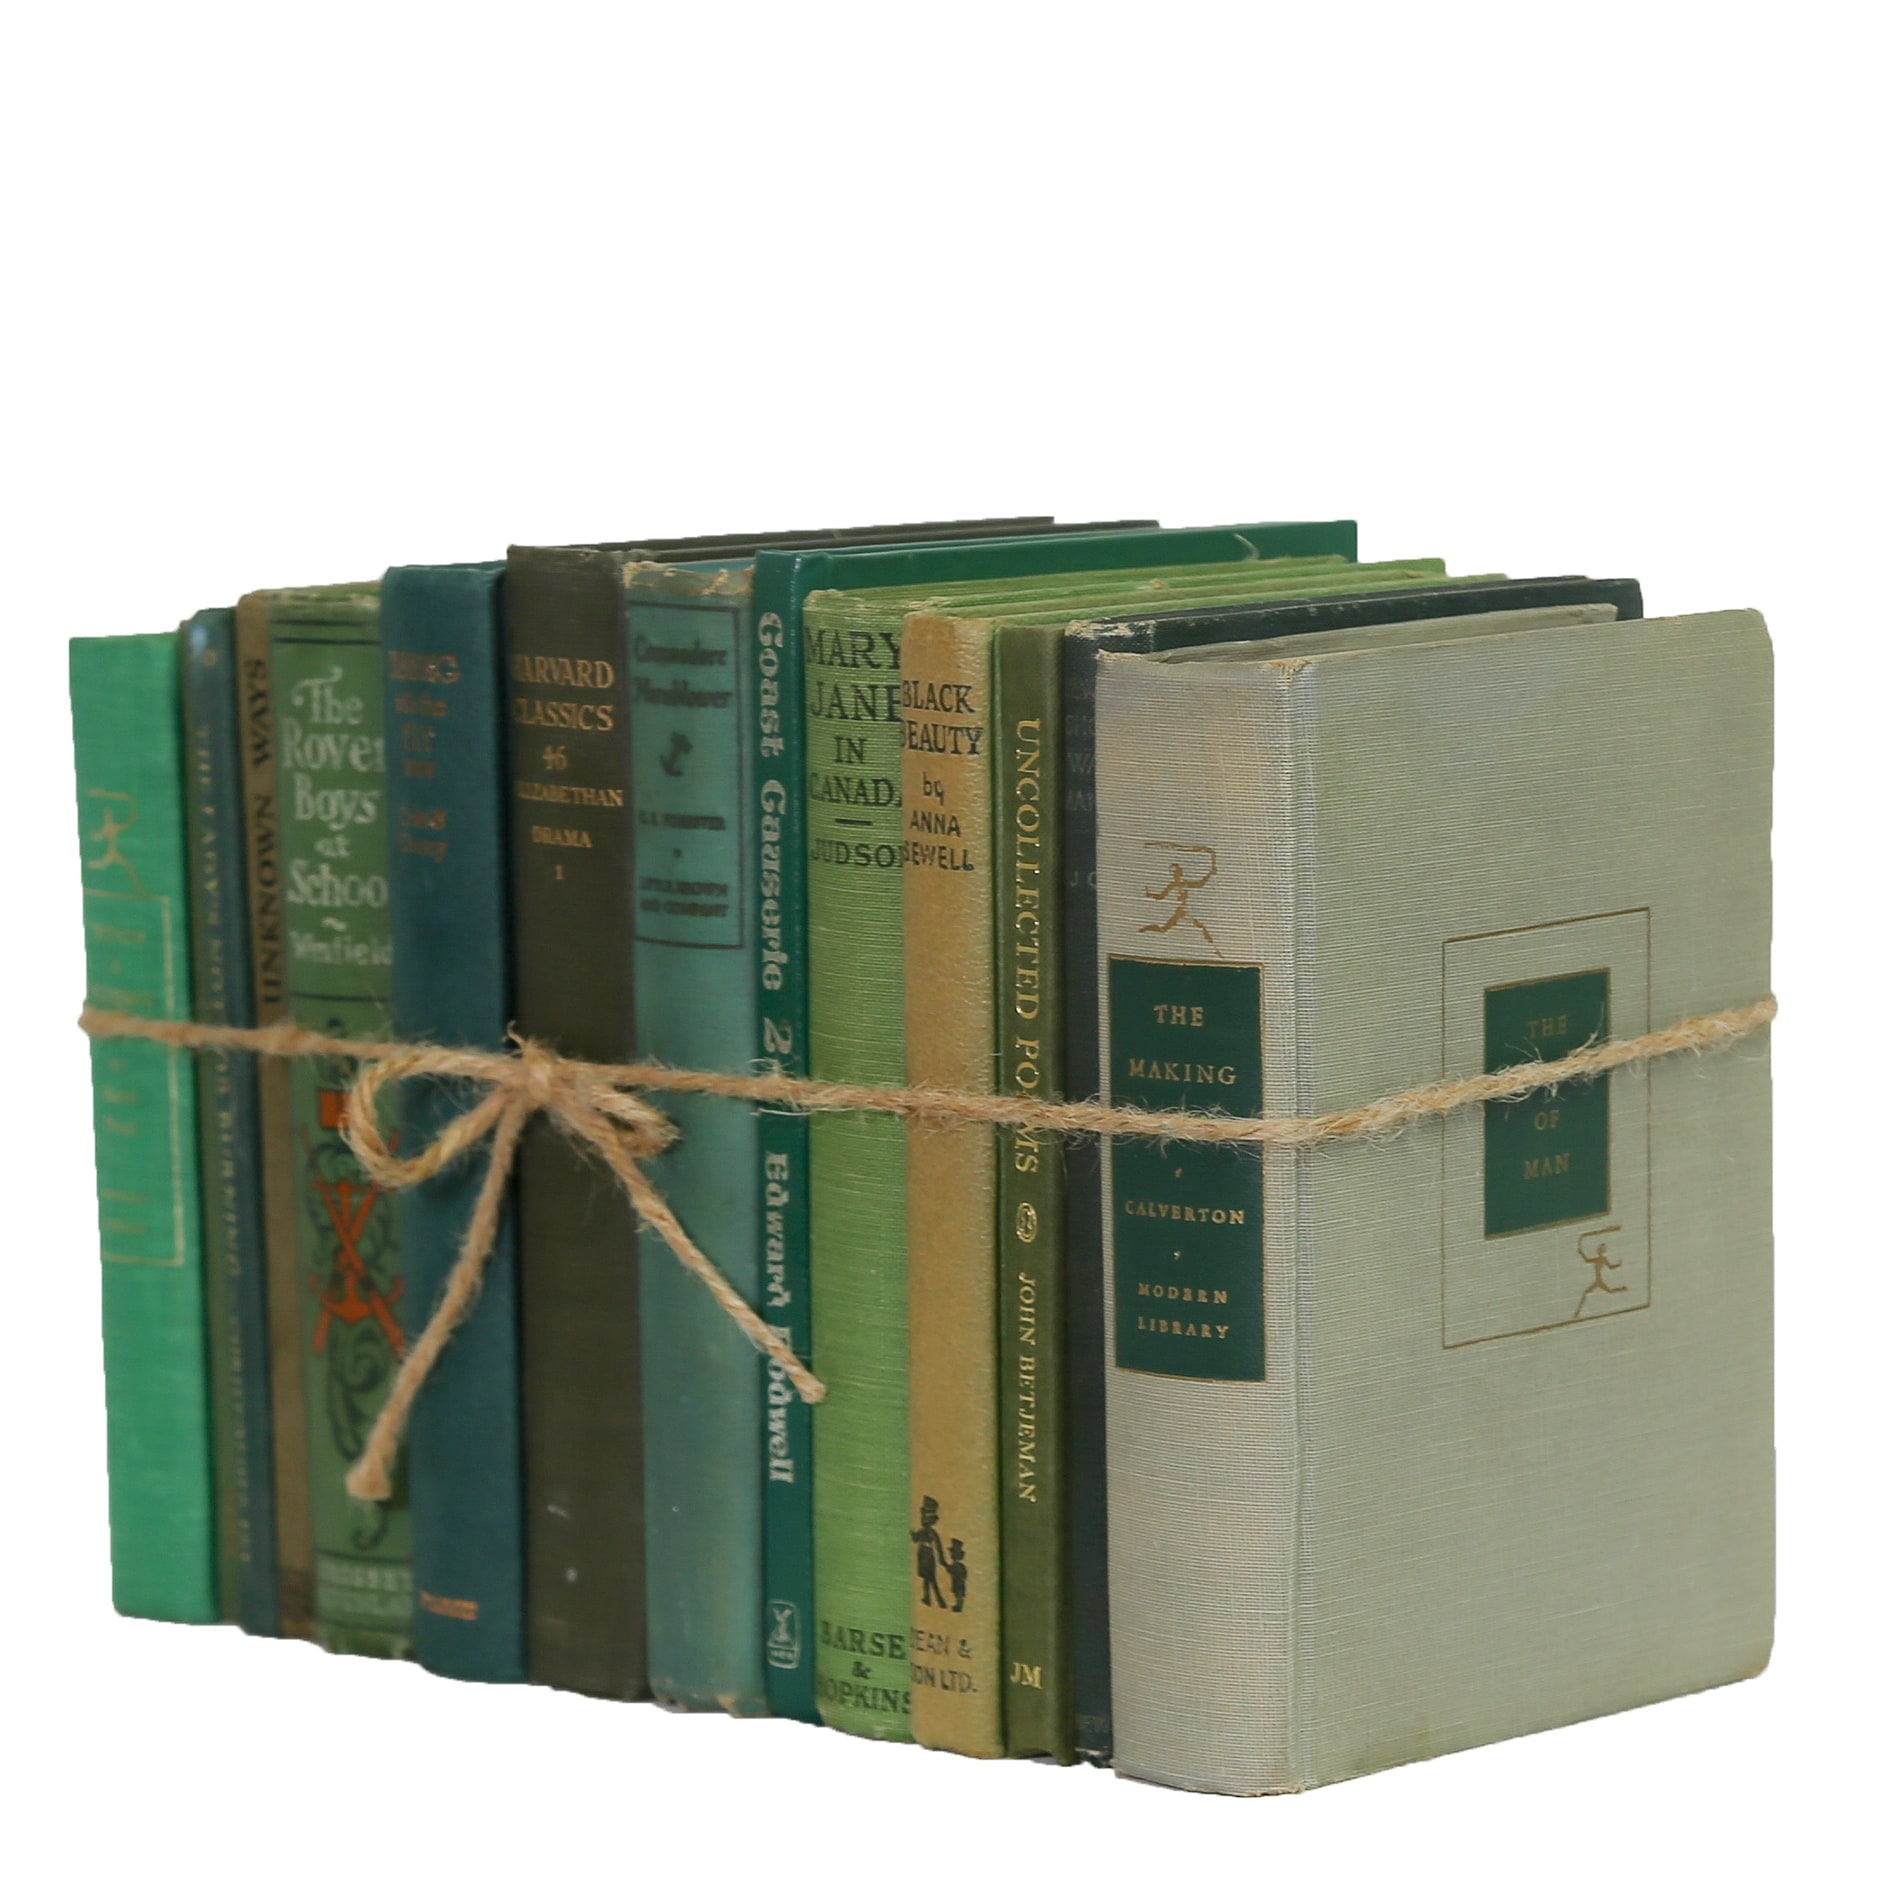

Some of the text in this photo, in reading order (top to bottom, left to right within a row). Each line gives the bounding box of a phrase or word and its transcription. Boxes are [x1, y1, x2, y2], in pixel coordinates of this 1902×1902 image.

[805, 626, 902, 670] MARY
[290, 666, 364, 725] The
[902, 679, 976, 714] BLACK
[833, 736, 868, 764] IN
[293, 771, 383, 831] Boys
[809, 772, 902, 807] CANAD
[922, 771, 944, 806] by
[244, 658, 283, 1005] UNKNOWN WAYS
[531, 825, 593, 848] DRAMA
[910, 810, 961, 838] ANNA
[812, 837, 903, 868] JUDSO
[286, 857, 390, 909] Schoo
[1014, 717, 1042, 1174] UNCOLLECTED POMS
[1153, 1004, 1205, 1028] THE
[1527, 1015, 1569, 1040] THE
[1128, 1058, 1238, 1086] MAKING
[1534, 1109, 1561, 1132] OF
[1523, 1153, 1570, 1181] MAN
[1125, 1201, 1246, 1226] CALVERTON
[1138, 1283, 1229, 1305] MODERN
[1138, 1316, 1230, 1340] LIBRARY
[1017, 1272, 1037, 1503] JOHN BETJEMAN
[819, 1620, 907, 1660] BARSE
[910, 1627, 972, 1659] EAN &
[1010, 1662, 1044, 1690] JM
